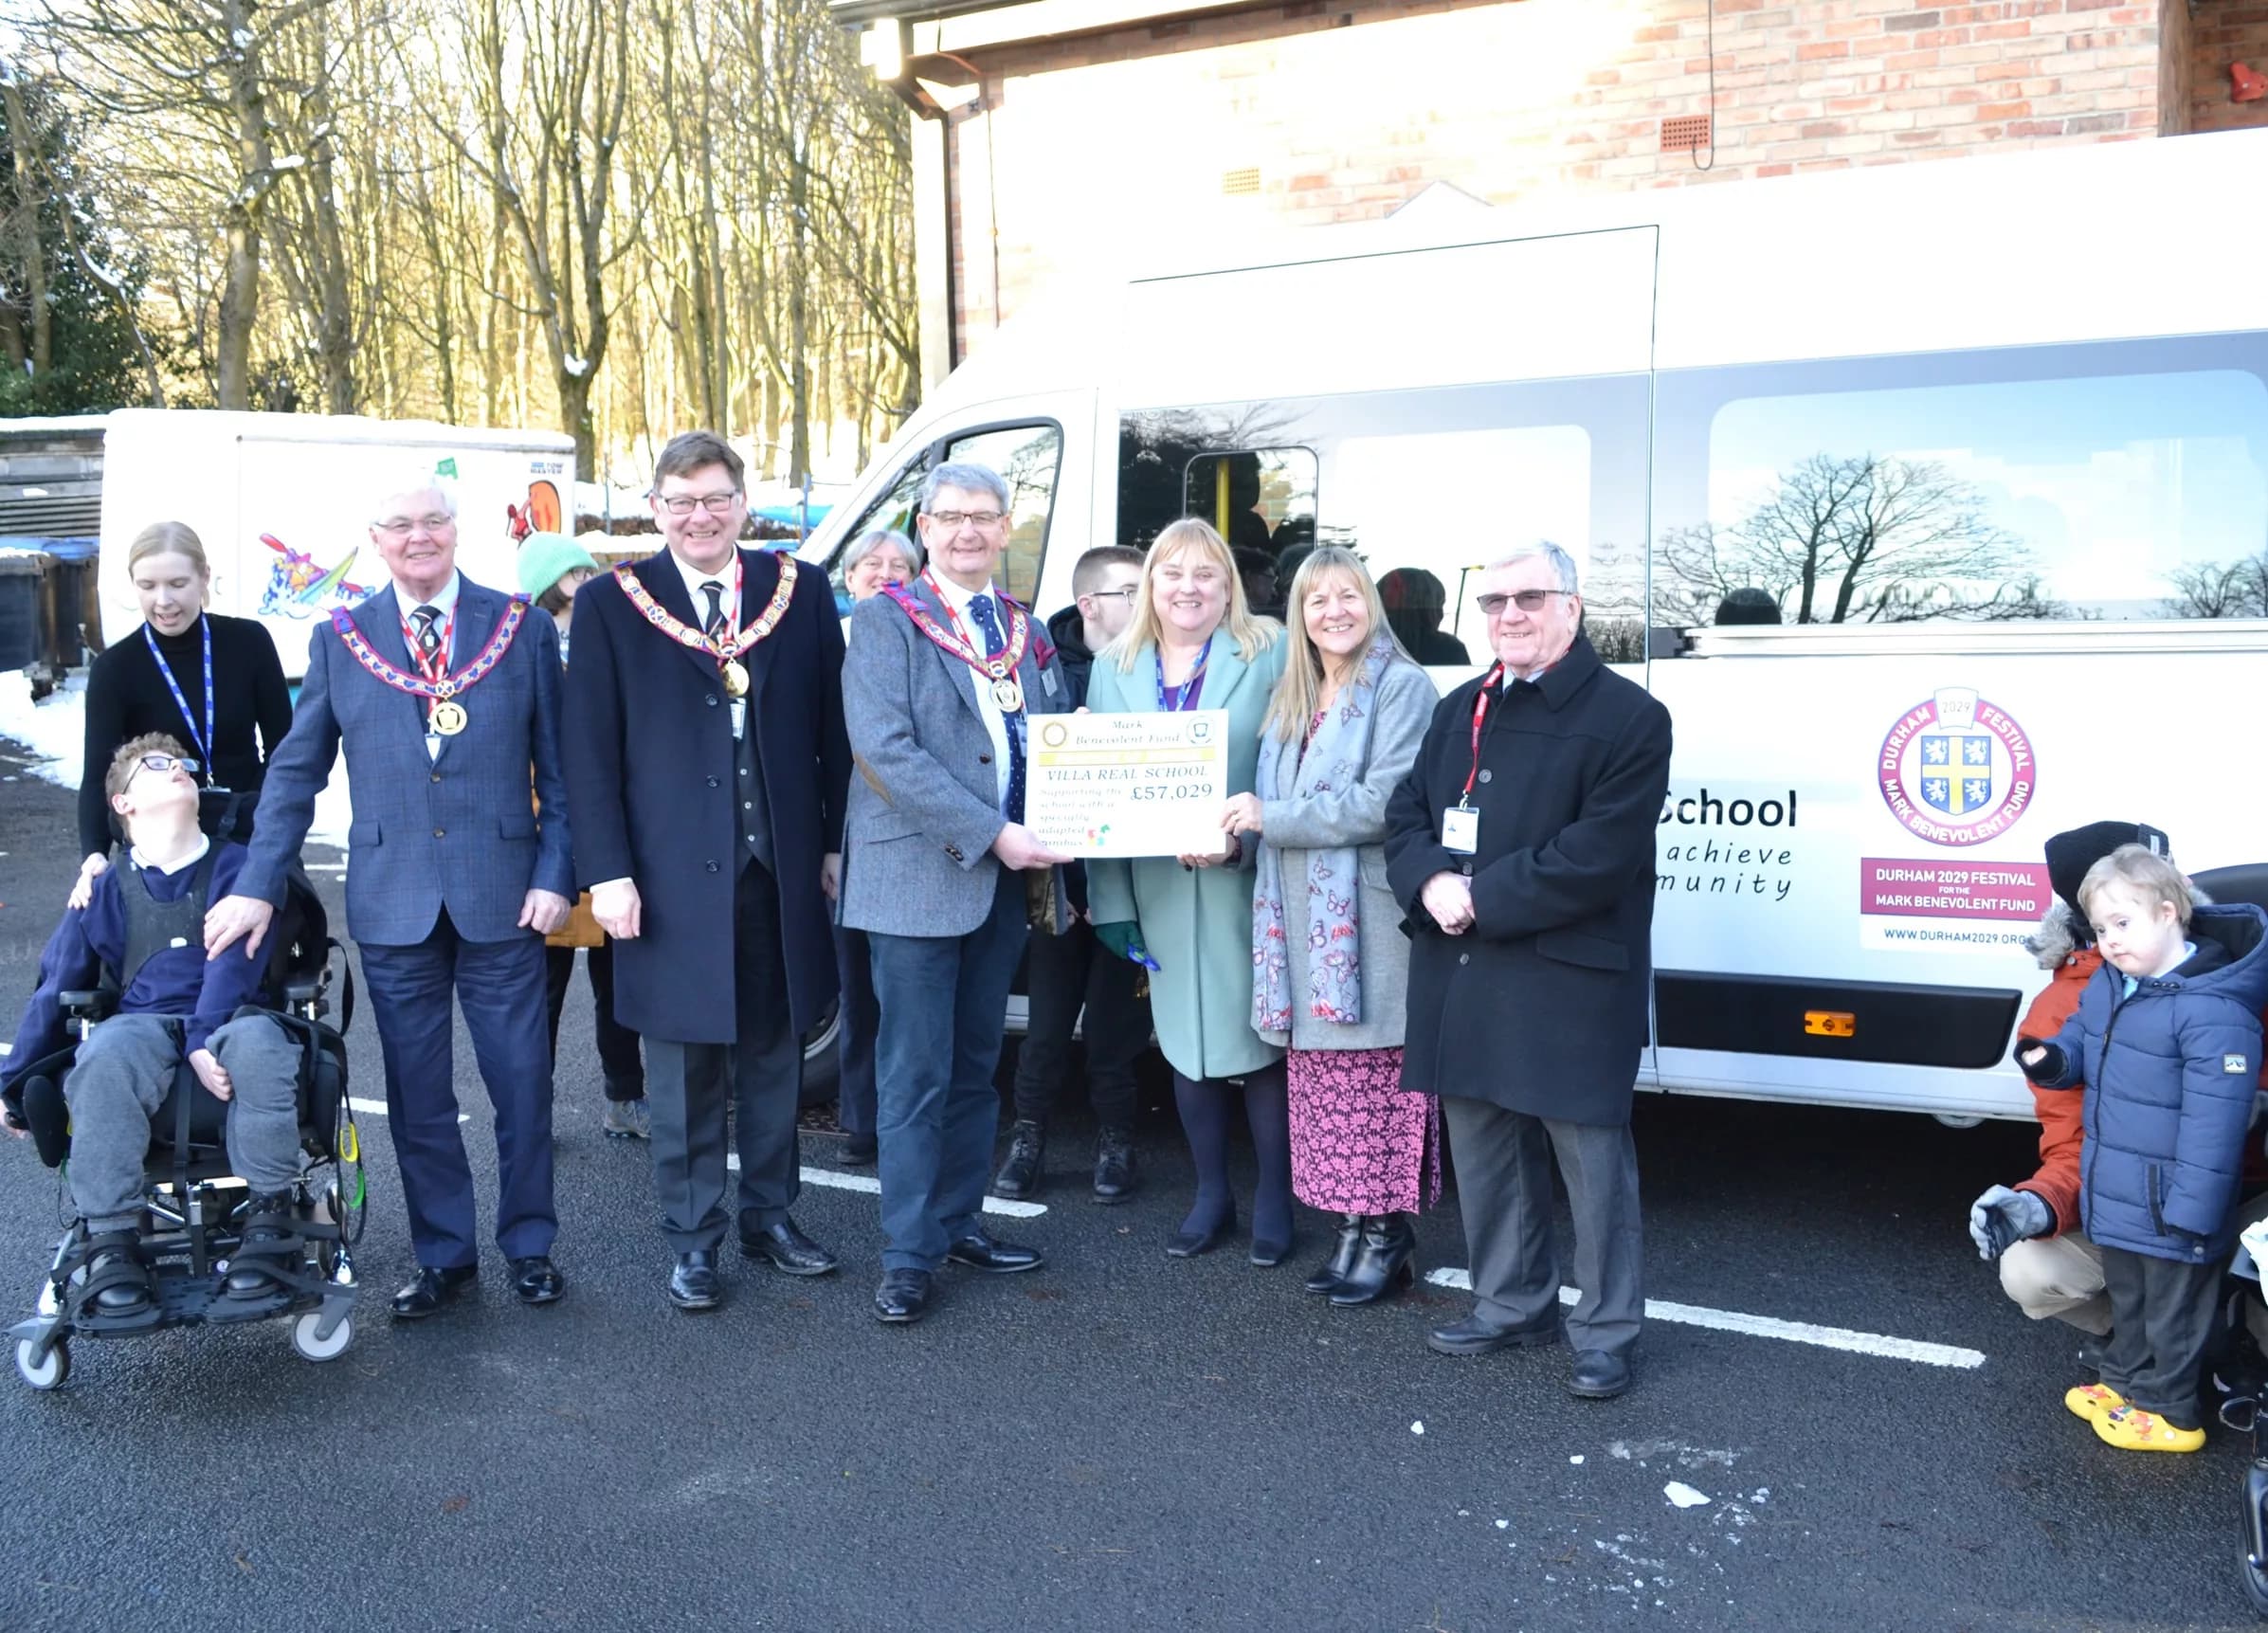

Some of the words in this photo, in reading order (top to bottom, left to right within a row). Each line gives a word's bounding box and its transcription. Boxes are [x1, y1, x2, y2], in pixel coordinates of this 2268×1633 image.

[1942, 701, 1971, 713] 2029
[1112, 719, 1143, 730] Mark
[1076, 735, 1143, 746] Benevolent
[1149, 734, 1181, 744] Fund
[1882, 707, 1932, 771] DURHAM
[1981, 707, 2030, 771] FESTIVAL
[1046, 770, 1091, 781] VILLA
[1098, 768, 1138, 780] REAL
[1145, 765, 1208, 779] SCHOOL
[1131, 783, 1212, 801] £57,029
[1884, 779, 1914, 821] MARK
[1909, 814, 2005, 843] BENEVOLENT
[2002, 781, 2030, 821] FUND
[1666, 839, 1791, 864] achieve
[1876, 868, 1935, 883] DURHAM
[1937, 870, 1968, 884] 2029
[1970, 872, 2036, 887] FESTIVAL
[1876, 894, 1913, 907] MARK
[1914, 896, 1999, 910] BENEVOLENT
[2000, 898, 2036, 912] FUND
